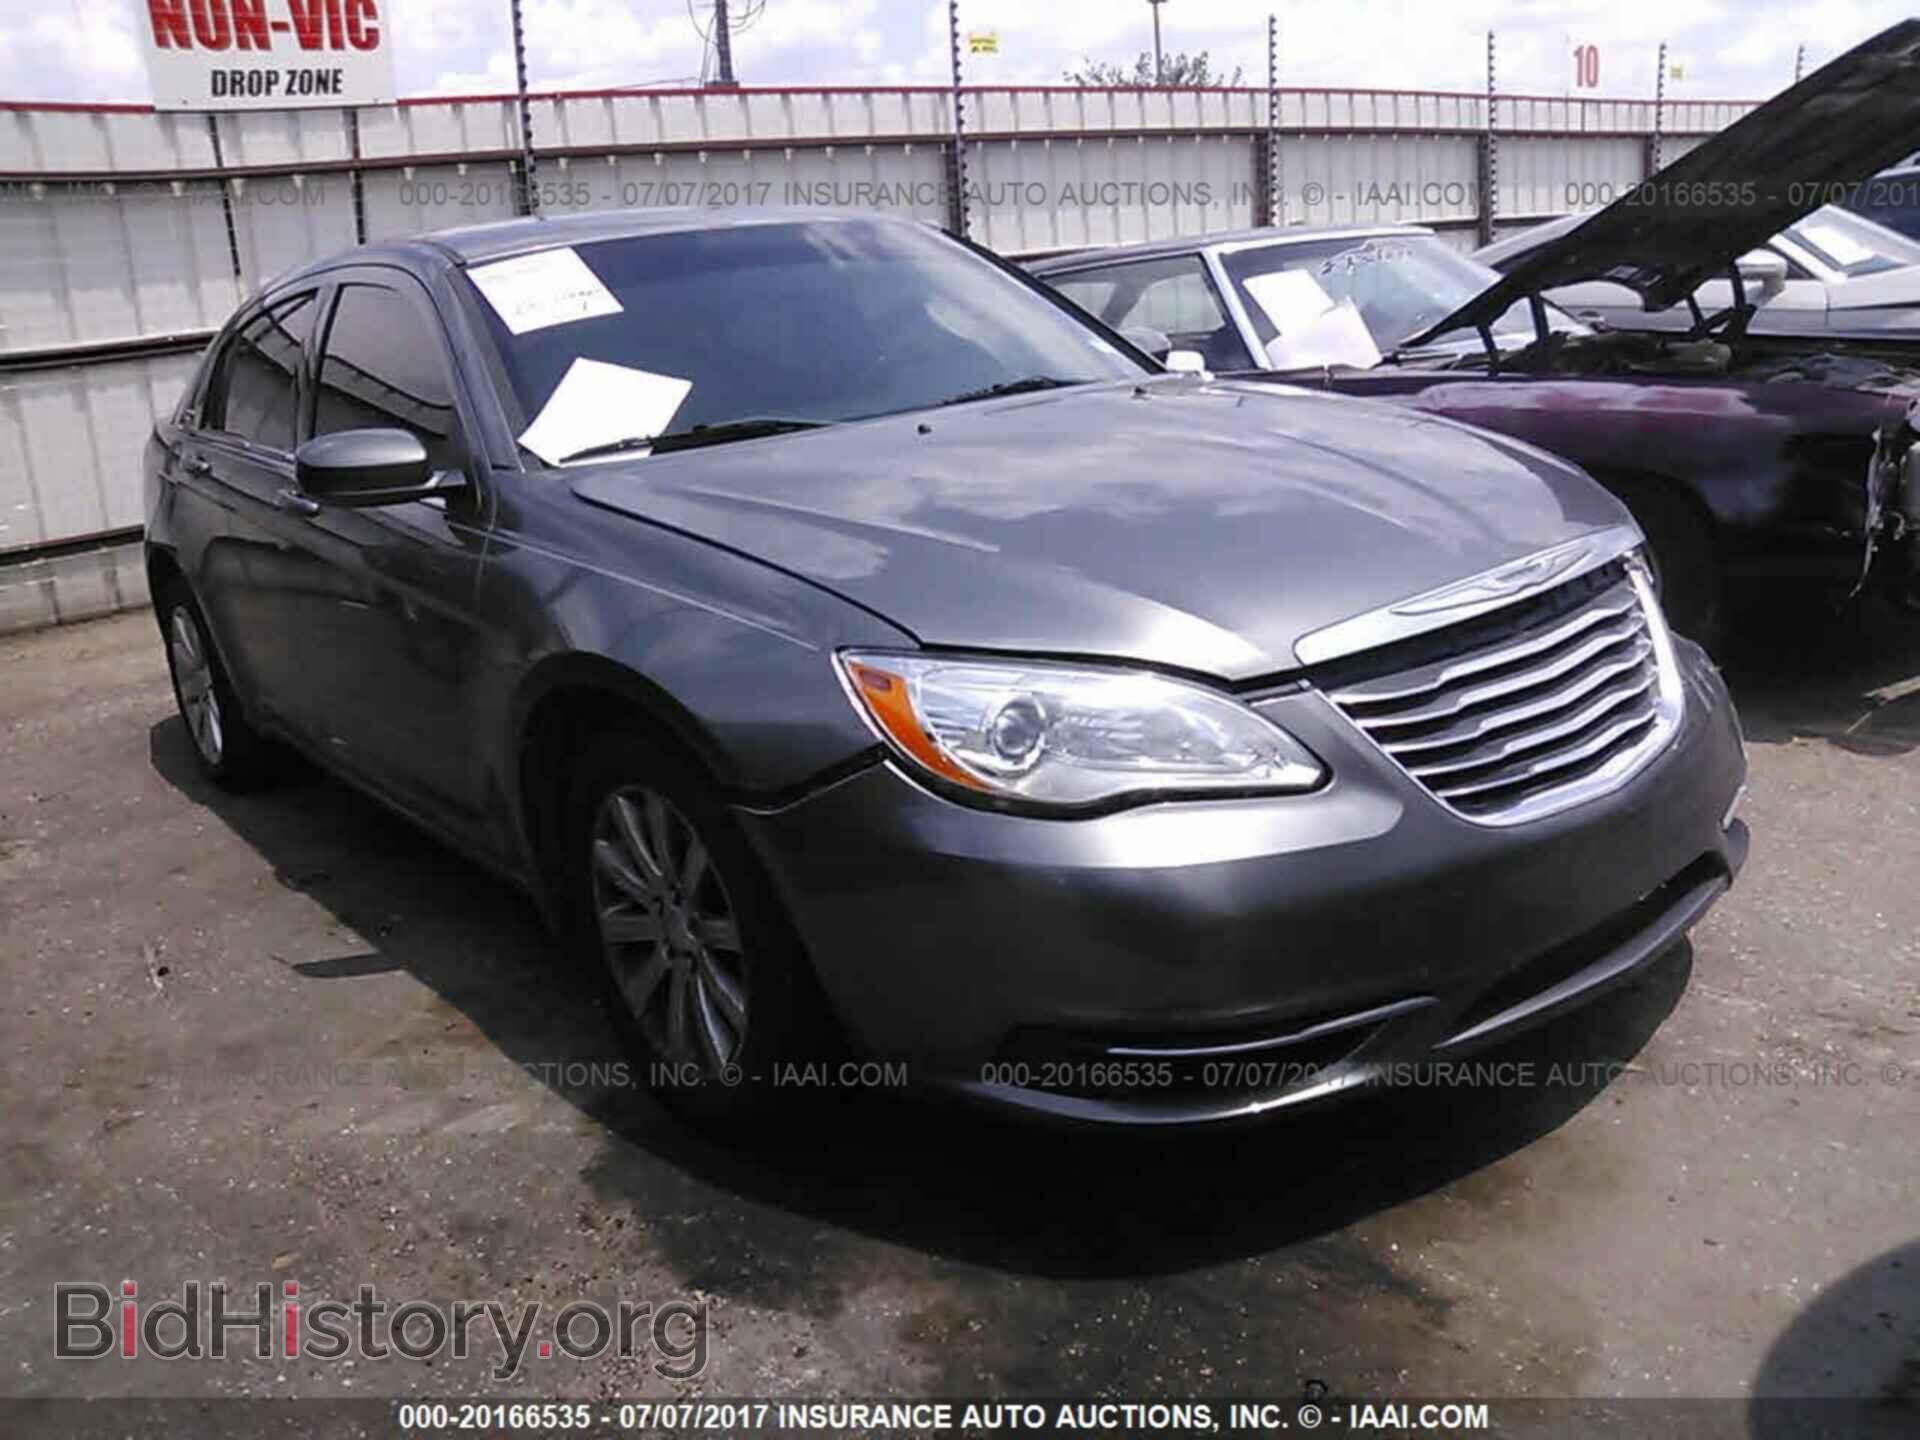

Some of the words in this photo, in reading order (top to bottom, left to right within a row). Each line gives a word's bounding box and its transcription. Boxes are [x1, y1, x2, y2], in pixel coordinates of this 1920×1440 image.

[147, 0, 380, 51] NON-VIC
[211, 70, 280, 97] DROP
[285, 69, 343, 96] ZONE
[1573, 45, 1598, 88] 10
